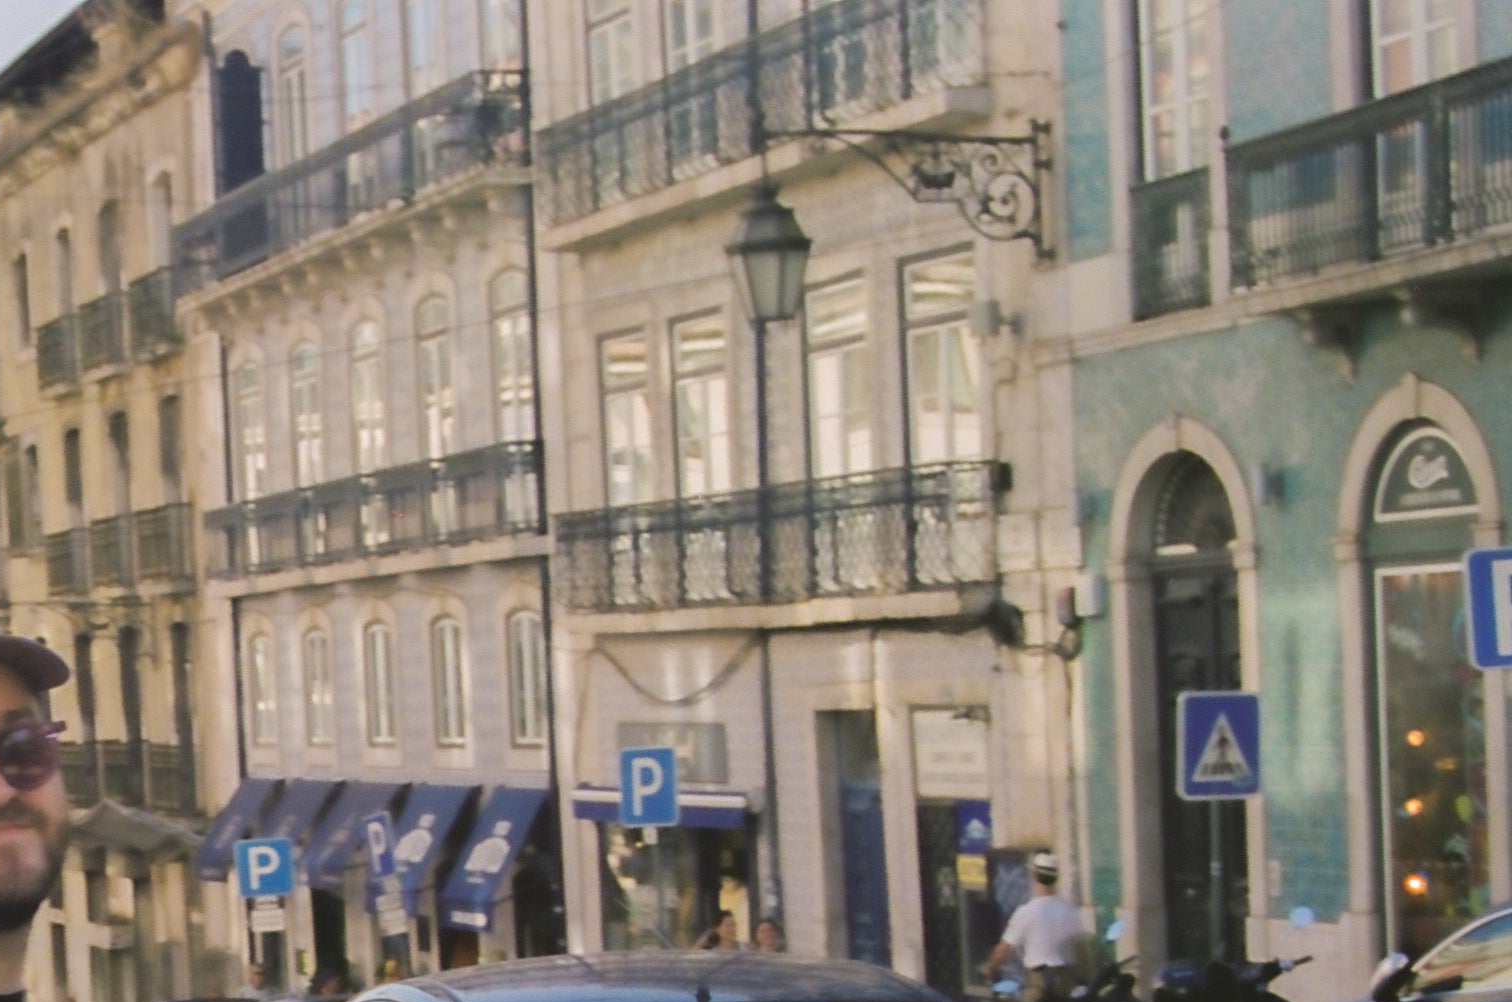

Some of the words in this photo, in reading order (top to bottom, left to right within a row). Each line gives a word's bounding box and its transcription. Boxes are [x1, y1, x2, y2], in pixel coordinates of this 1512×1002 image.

[631, 757, 664, 816] P
[248, 846, 280, 890] P
[367, 821, 386, 873] P
